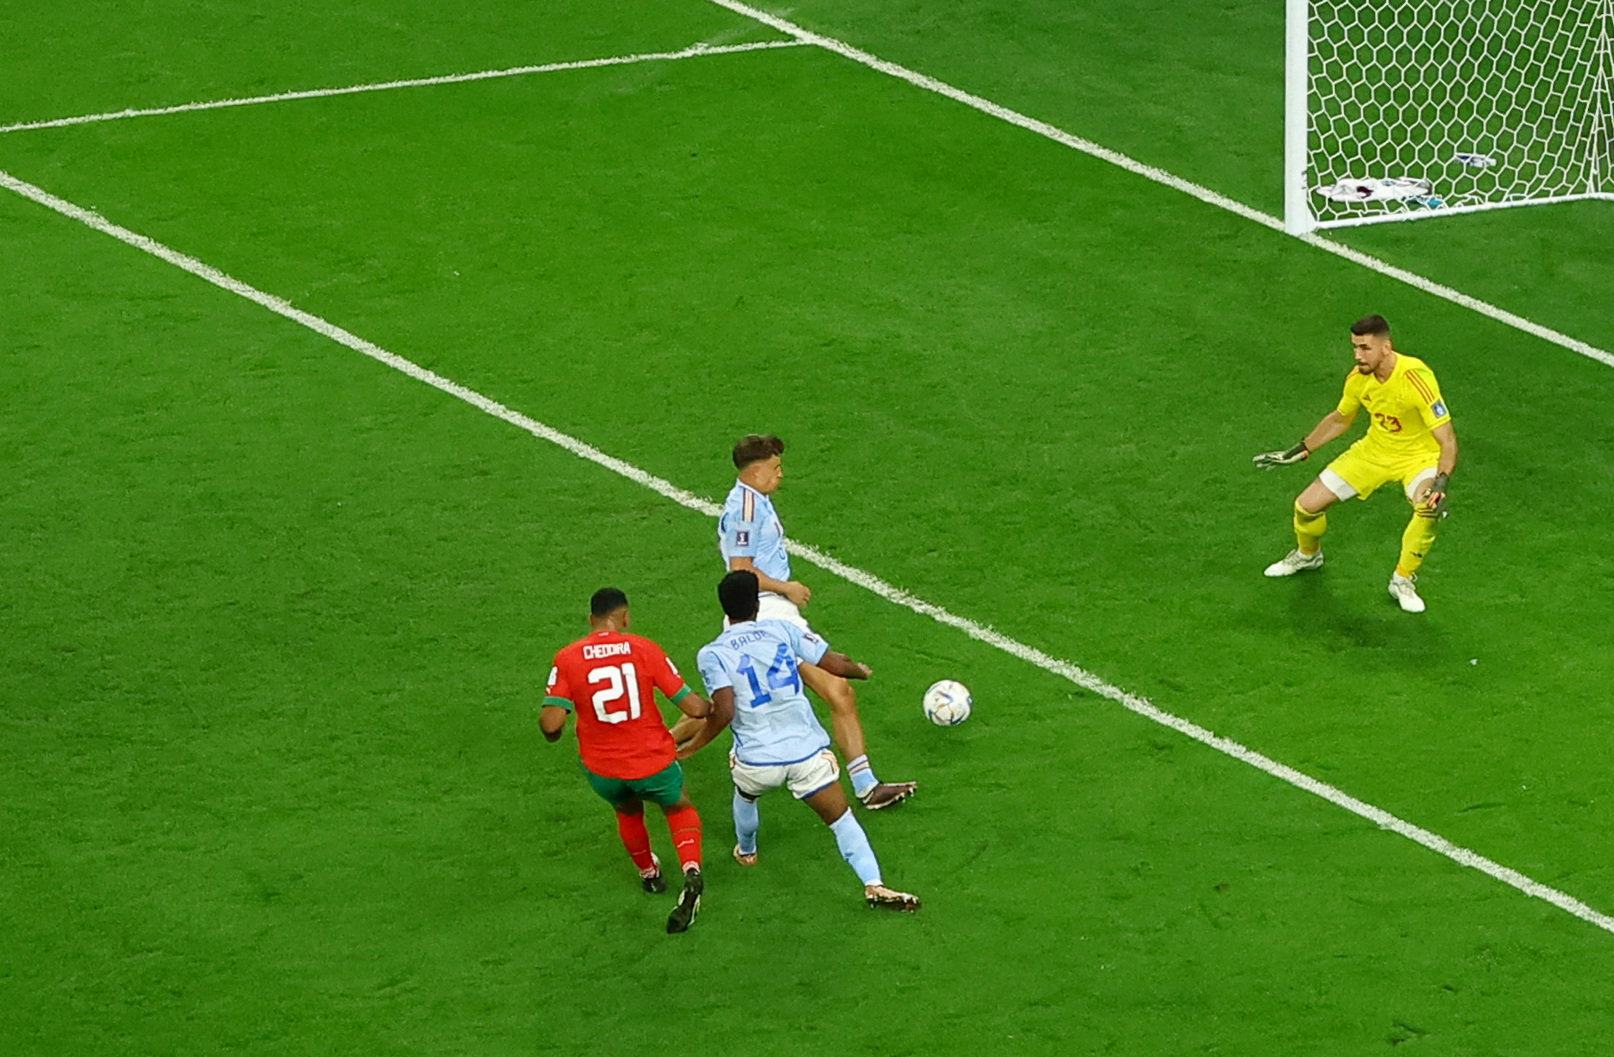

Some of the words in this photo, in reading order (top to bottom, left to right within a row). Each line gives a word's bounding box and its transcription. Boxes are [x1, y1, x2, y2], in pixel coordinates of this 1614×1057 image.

[1374, 412, 1402, 433] 23
[583, 641, 631, 660] CHEDDIRA
[587, 662, 641, 724] 21
[736, 643, 800, 709] 14
